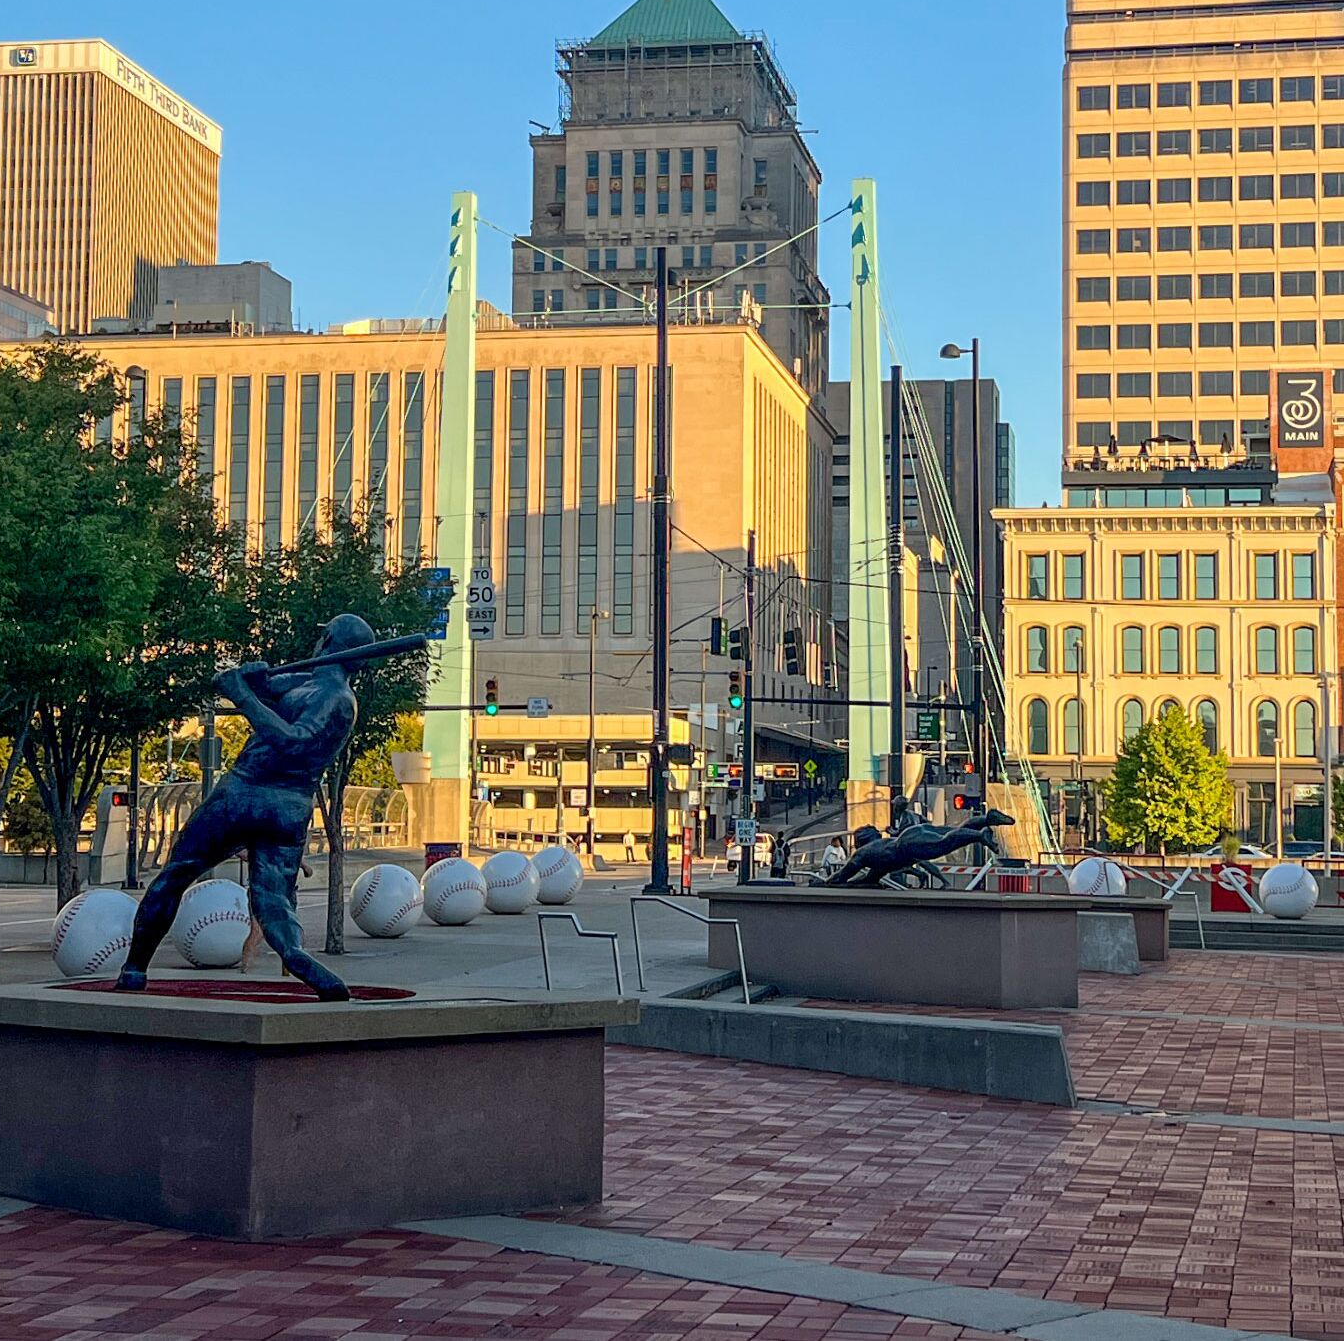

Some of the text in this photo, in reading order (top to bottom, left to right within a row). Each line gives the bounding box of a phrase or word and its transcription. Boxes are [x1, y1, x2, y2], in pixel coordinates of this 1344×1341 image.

[117, 58, 208, 140] FIFTH THIRD BANK
[1284, 431, 1319, 441] MAIN
[473, 569, 490, 579] TO
[468, 586, 493, 603] 50
[468, 610, 493, 619] EAST
